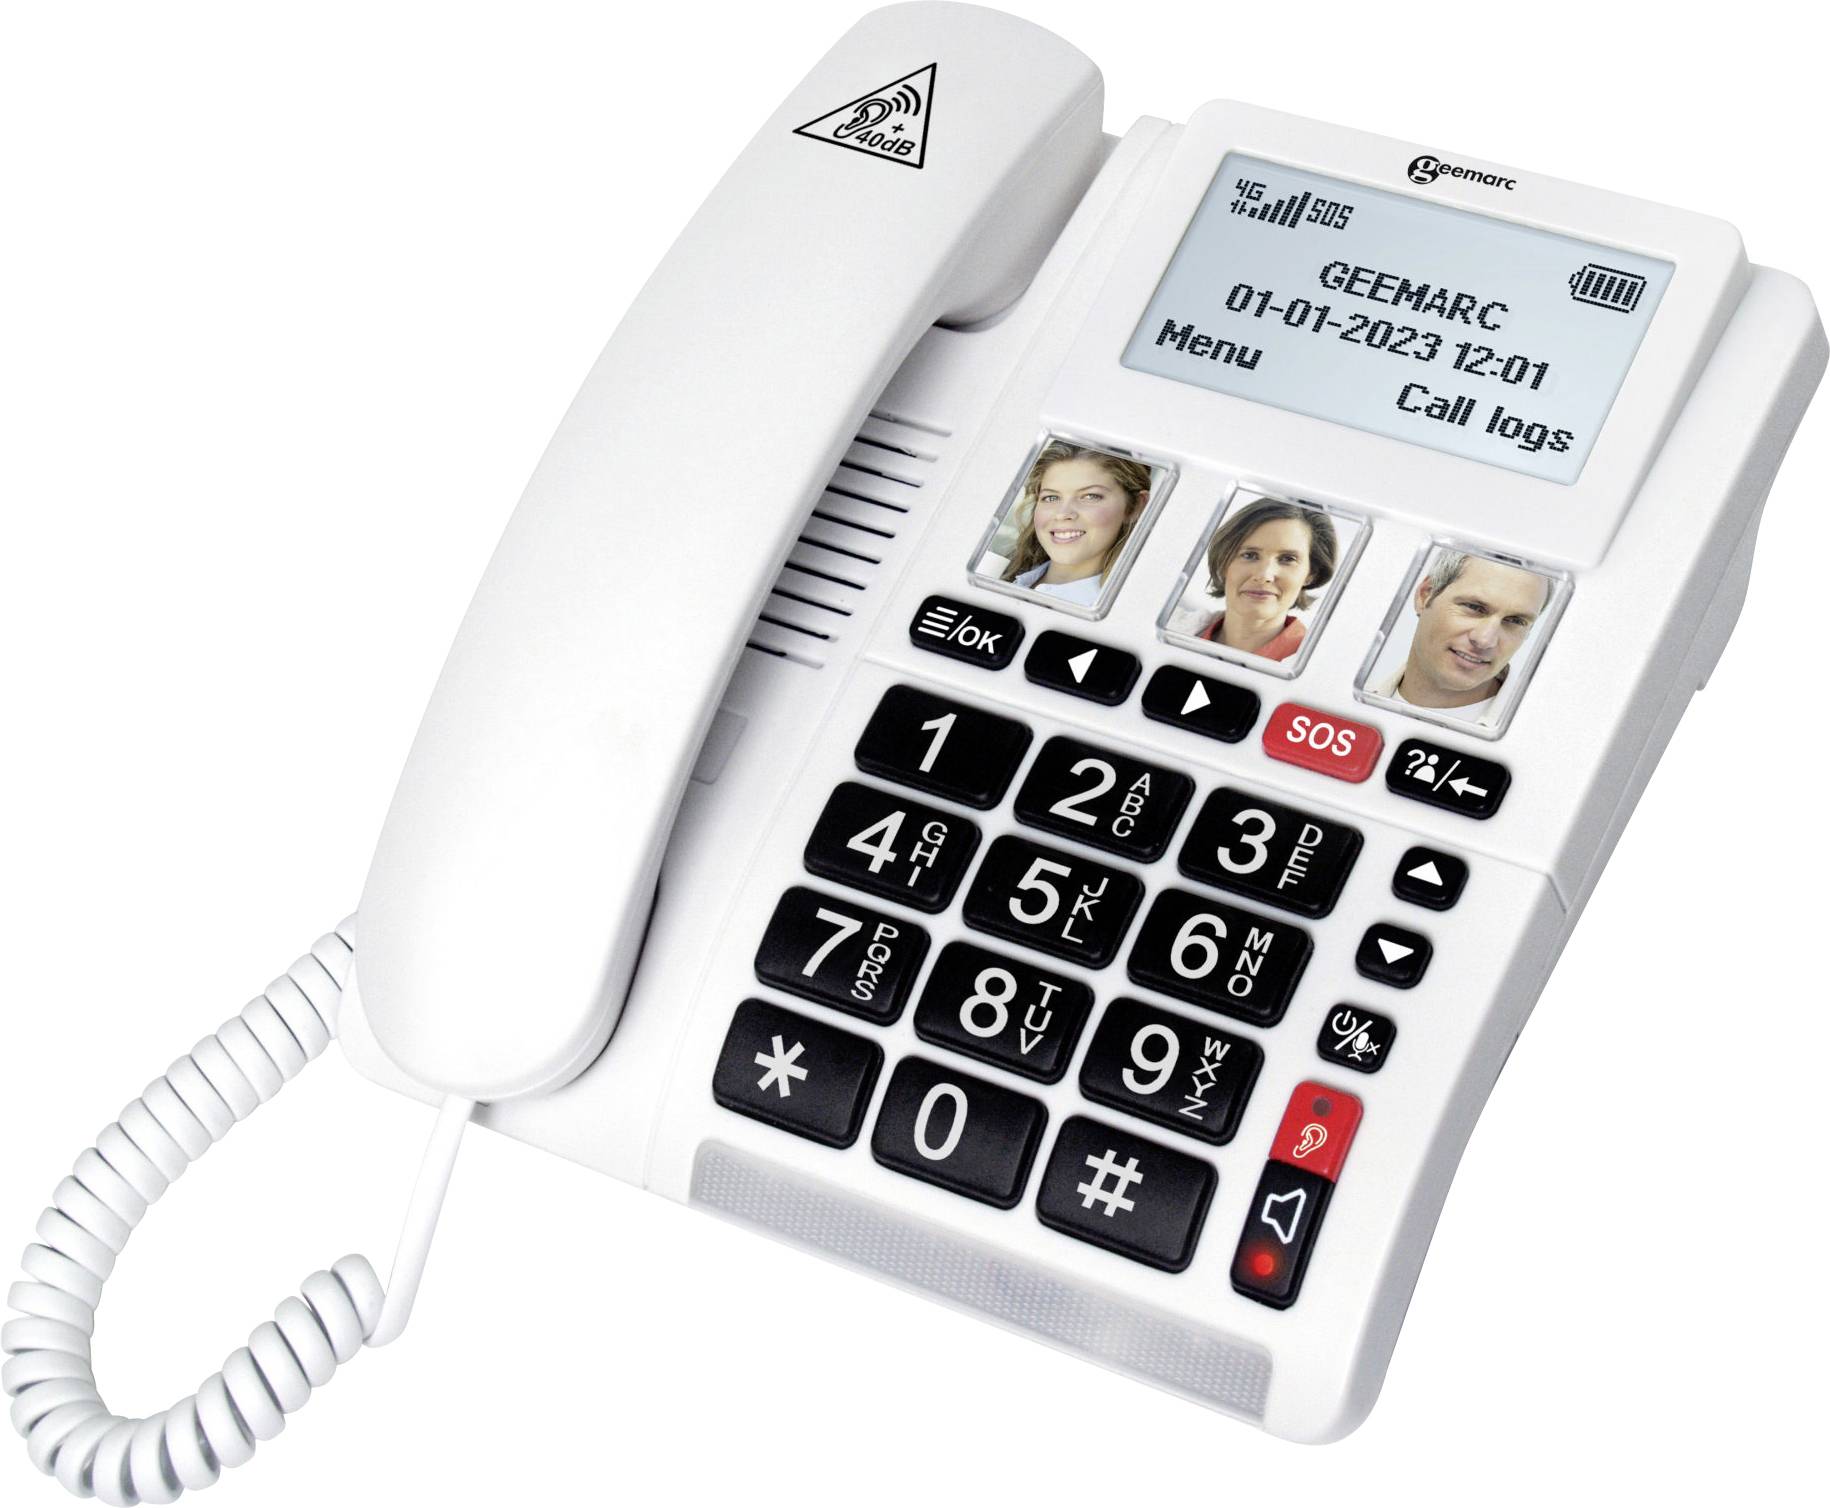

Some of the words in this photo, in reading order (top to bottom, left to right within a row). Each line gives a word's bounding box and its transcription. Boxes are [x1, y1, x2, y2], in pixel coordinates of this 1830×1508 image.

[856, 130, 915, 155] 40dB
[1408, 156, 1516, 190] geemarc
[1236, 179, 1266, 201] 4G
[1307, 198, 1353, 229] SOS
[1319, 261, 1508, 330] GEEMARC
[1156, 319, 1262, 370] Menu
[1226, 284, 1442, 361] 01-01-2023
[1453, 343, 1549, 390] 12:01
[1397, 383, 1476, 426] Call
[1486, 406, 1573, 452] logs
[919, 713, 956, 772] 1
[1287, 716, 1356, 756] SOS
[1049, 759, 1116, 825] 2
[847, 811, 905, 873] 4
[1218, 809, 1275, 873] 3
[1009, 858, 1071, 924] 5
[802, 908, 862, 977] 7
[1171, 914, 1227, 978] 6
[960, 968, 1017, 1037] 8
[1123, 1024, 1179, 1094] 9
[914, 1083, 967, 1160] 0
